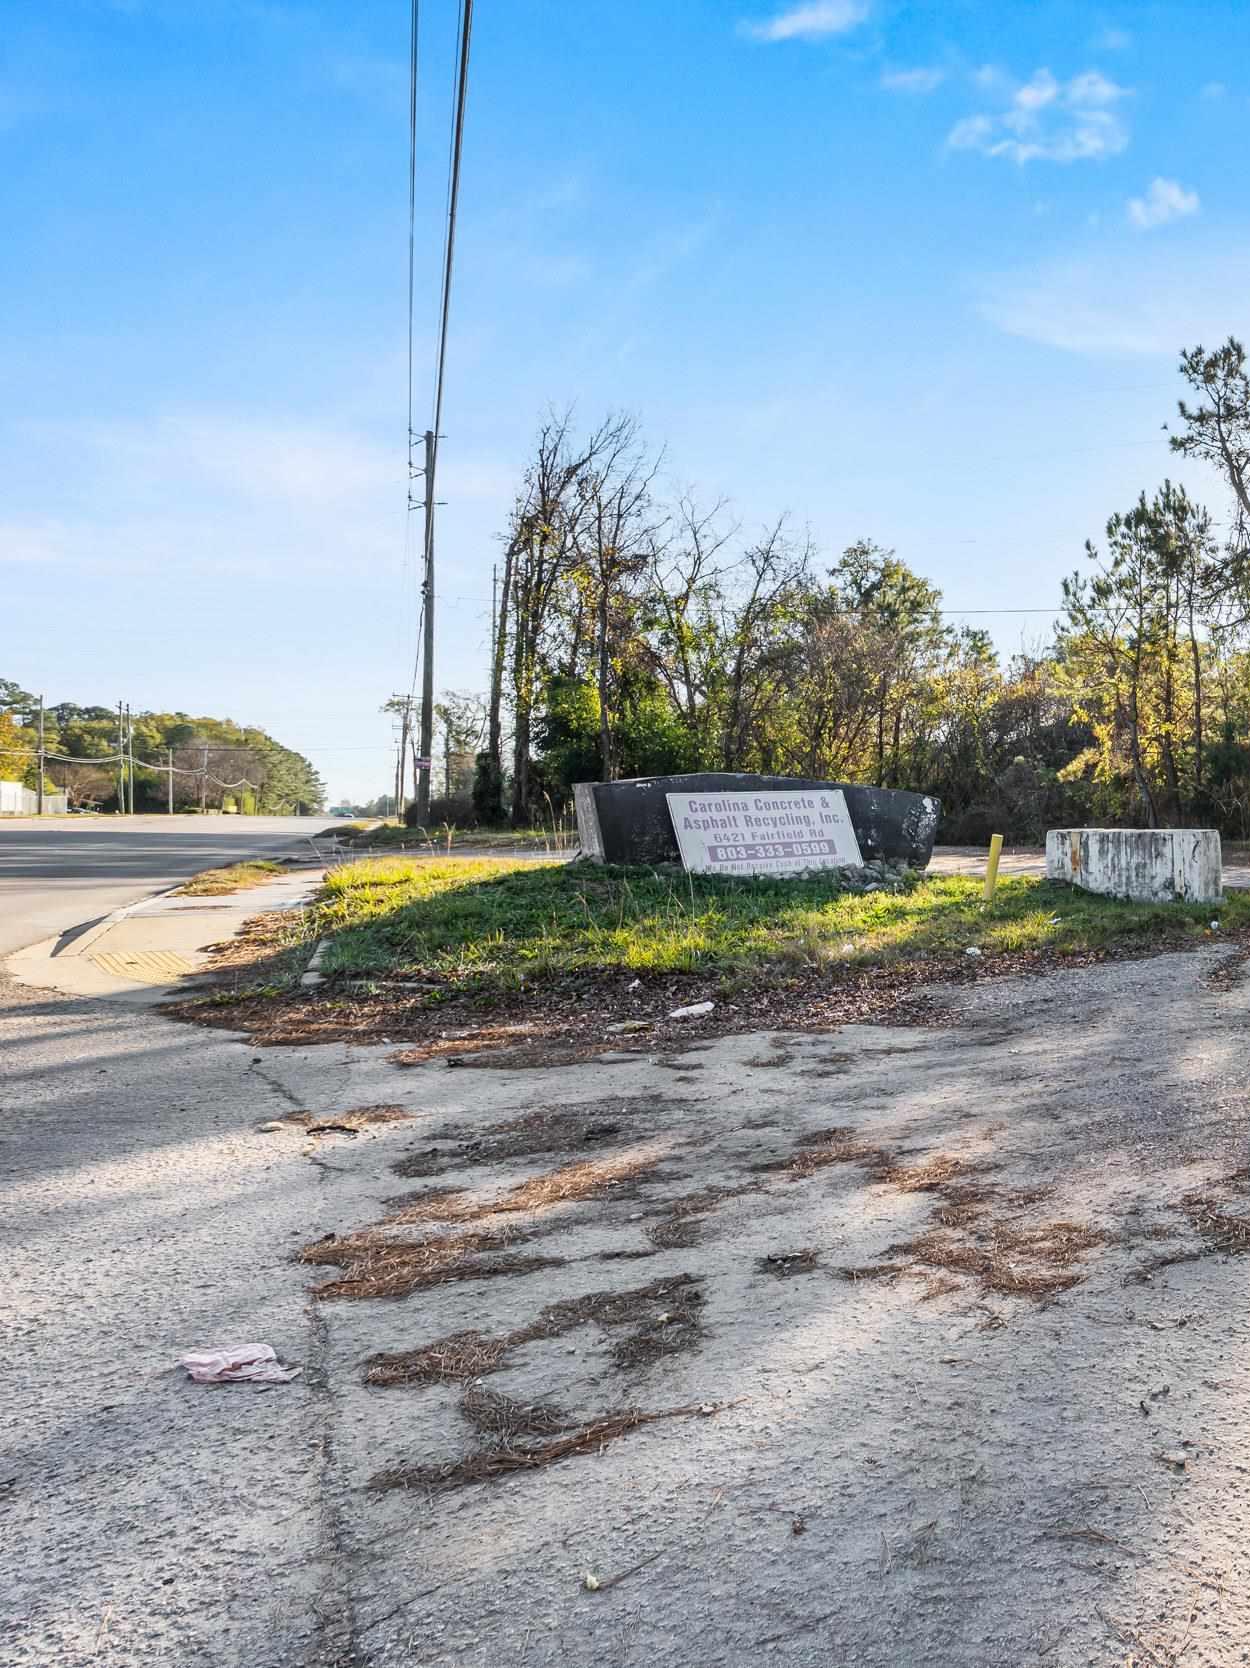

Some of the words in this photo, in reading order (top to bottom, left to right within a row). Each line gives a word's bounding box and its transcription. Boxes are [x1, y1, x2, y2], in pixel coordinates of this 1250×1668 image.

[688, 799, 749, 814] Carolina
[754, 797, 815, 811] Concrete
[820, 796, 831, 809] &
[683, 815, 739, 831] Asphalt
[744, 812, 816, 829] Recycling,
[820, 812, 845, 824] Inc.
[713, 832, 745, 843] 6421
[751, 830, 803, 841] Fairfield
[808, 829, 825, 838] Rd
[716, 842, 830, 860] 803-333-0599
